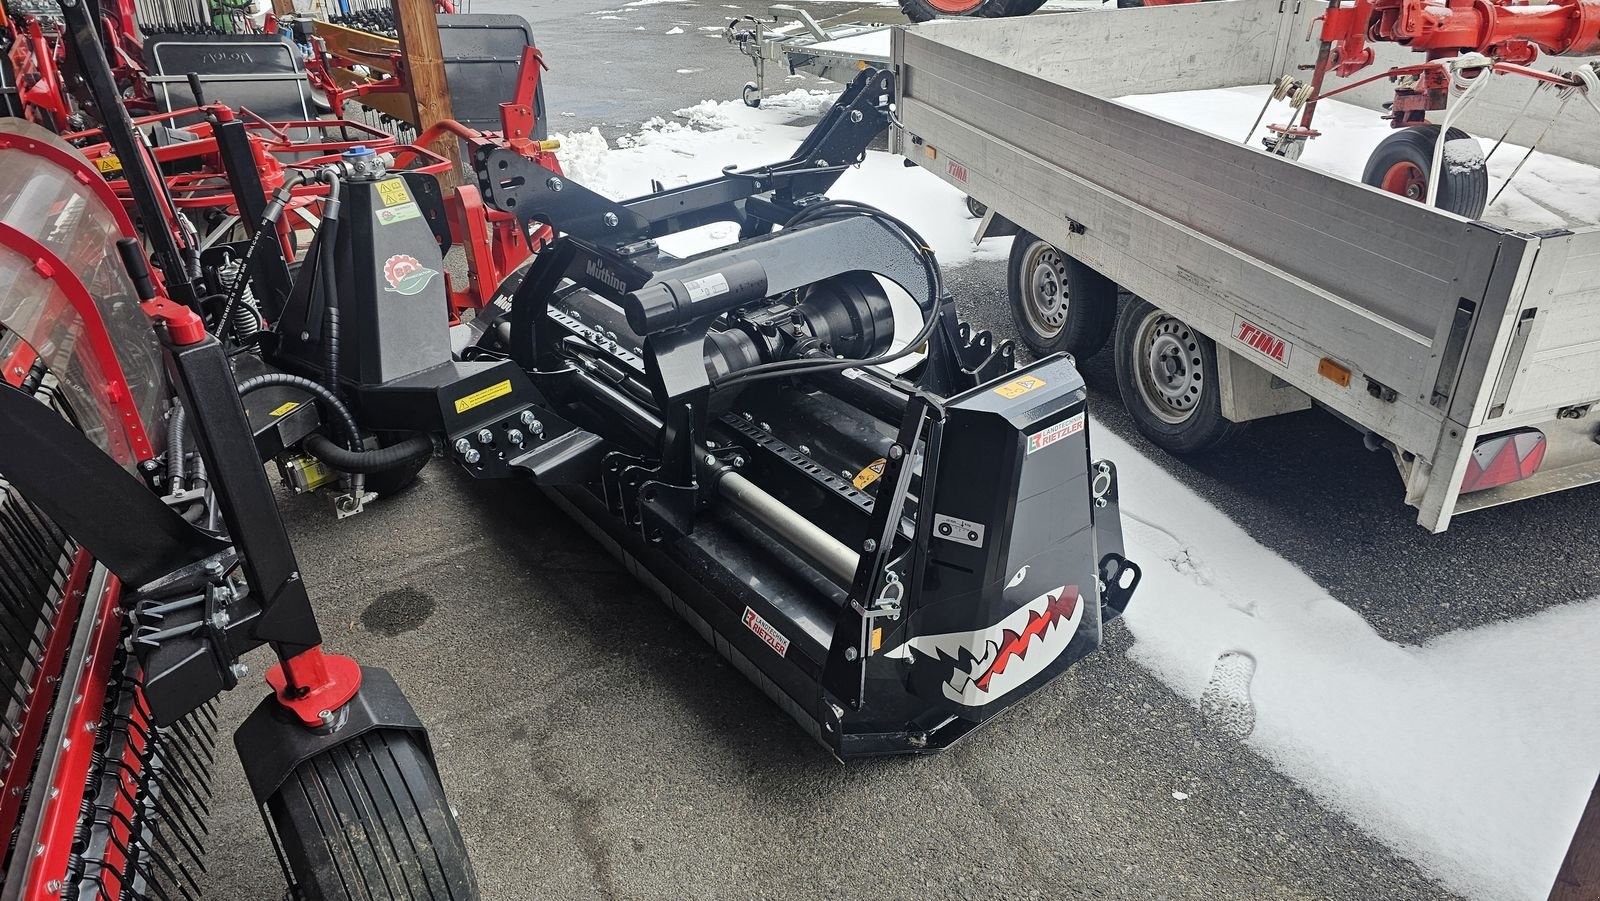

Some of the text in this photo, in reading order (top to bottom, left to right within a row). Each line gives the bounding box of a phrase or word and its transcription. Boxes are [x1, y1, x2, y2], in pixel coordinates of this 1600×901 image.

[586, 259, 627, 295] Müthing
[1042, 414, 1084, 436] LANDTECHNIK
[1043, 421, 1083, 446] RIETZLER
[752, 623, 785, 655] RIETZLER
[755, 616, 788, 646] LANDTECHNIK
